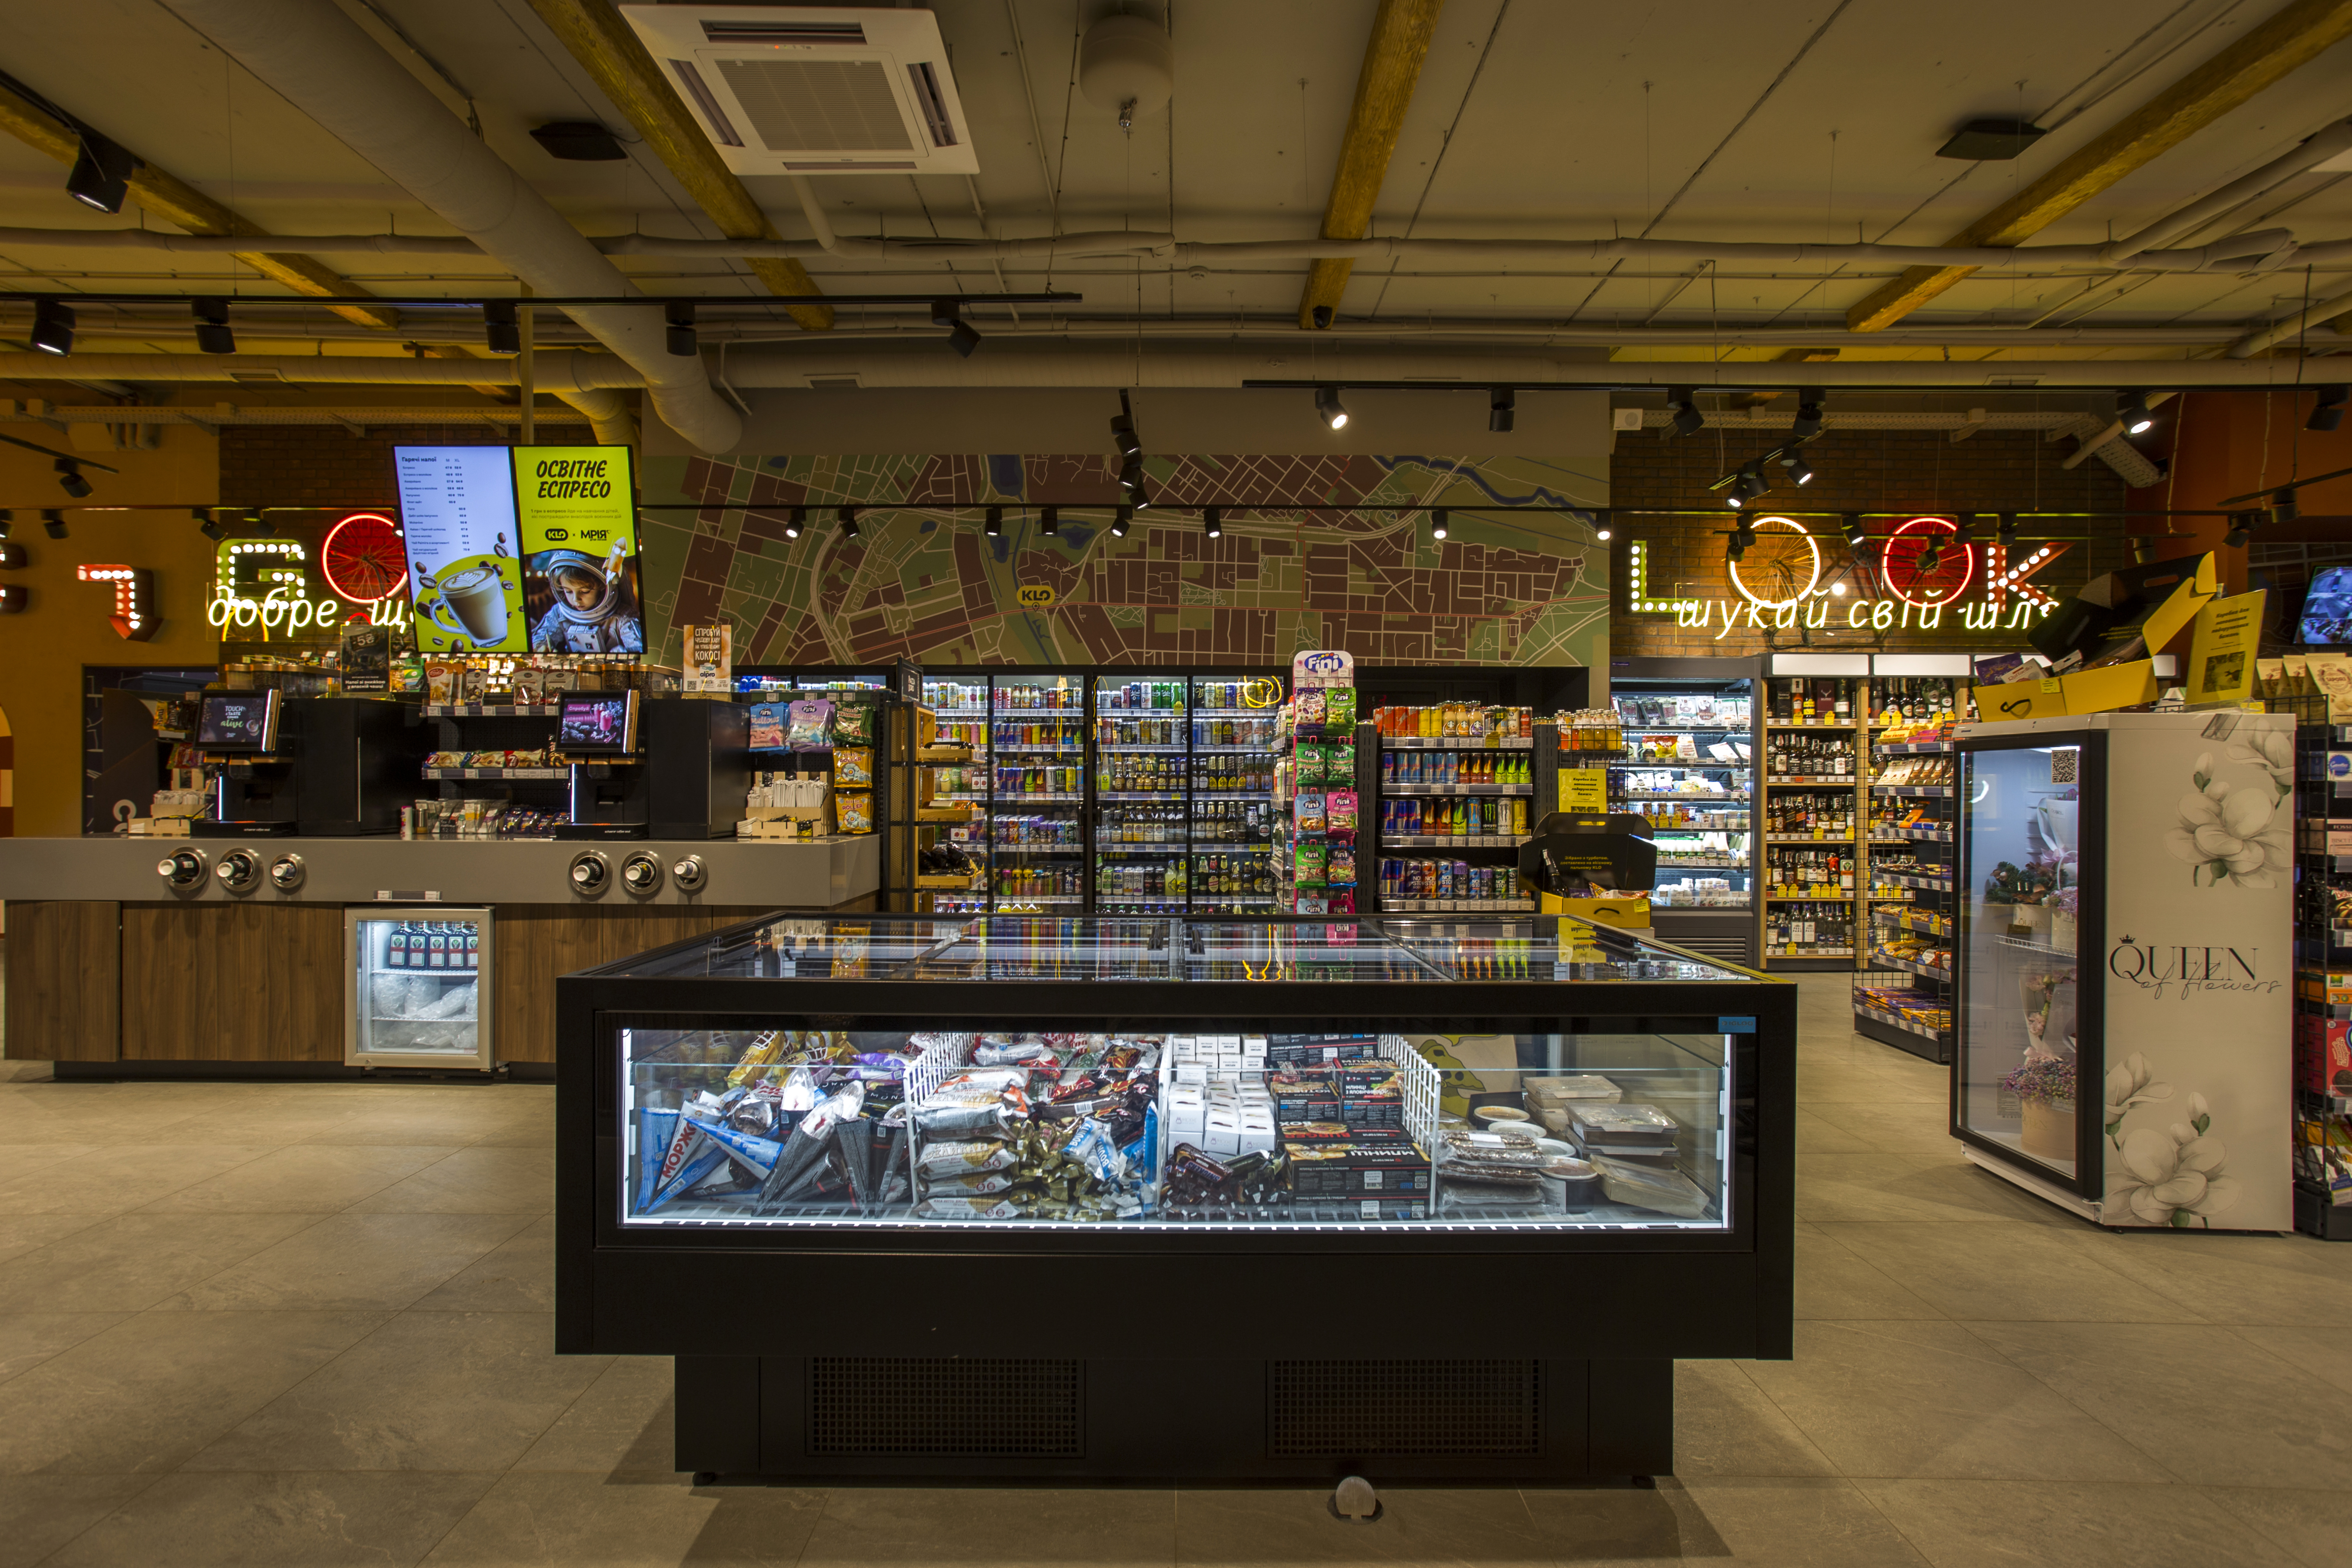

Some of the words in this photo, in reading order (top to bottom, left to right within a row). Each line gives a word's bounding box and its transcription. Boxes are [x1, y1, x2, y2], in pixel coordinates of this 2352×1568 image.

[536, 460, 607, 478] ОСВІТНЄ
[538, 480, 611, 499] ЕСПРЕСО
[581, 530, 607, 539] МРІЯ
[1022, 590, 1050, 601] KLO
[209, 586, 337, 637] добре
[1679, 590, 1829, 640] шукай
[1850, 590, 1943, 630] свій
[695, 627, 720, 636] СПРОБУЙ
[695, 651, 720, 660] КОКОСІ
[1308, 654, 1339, 670] Fini
[2008, 666, 2033, 681] Raffaello
[220, 718, 244, 728] alive
[2109, 945, 2259, 984] QUEEN
[2140, 962, 2174, 1000] of
[2181, 962, 2282, 1000] flowers
[1070, 1122, 1091, 1147] BOUNTY
[1185, 1160, 1221, 1182] SNICKERS
